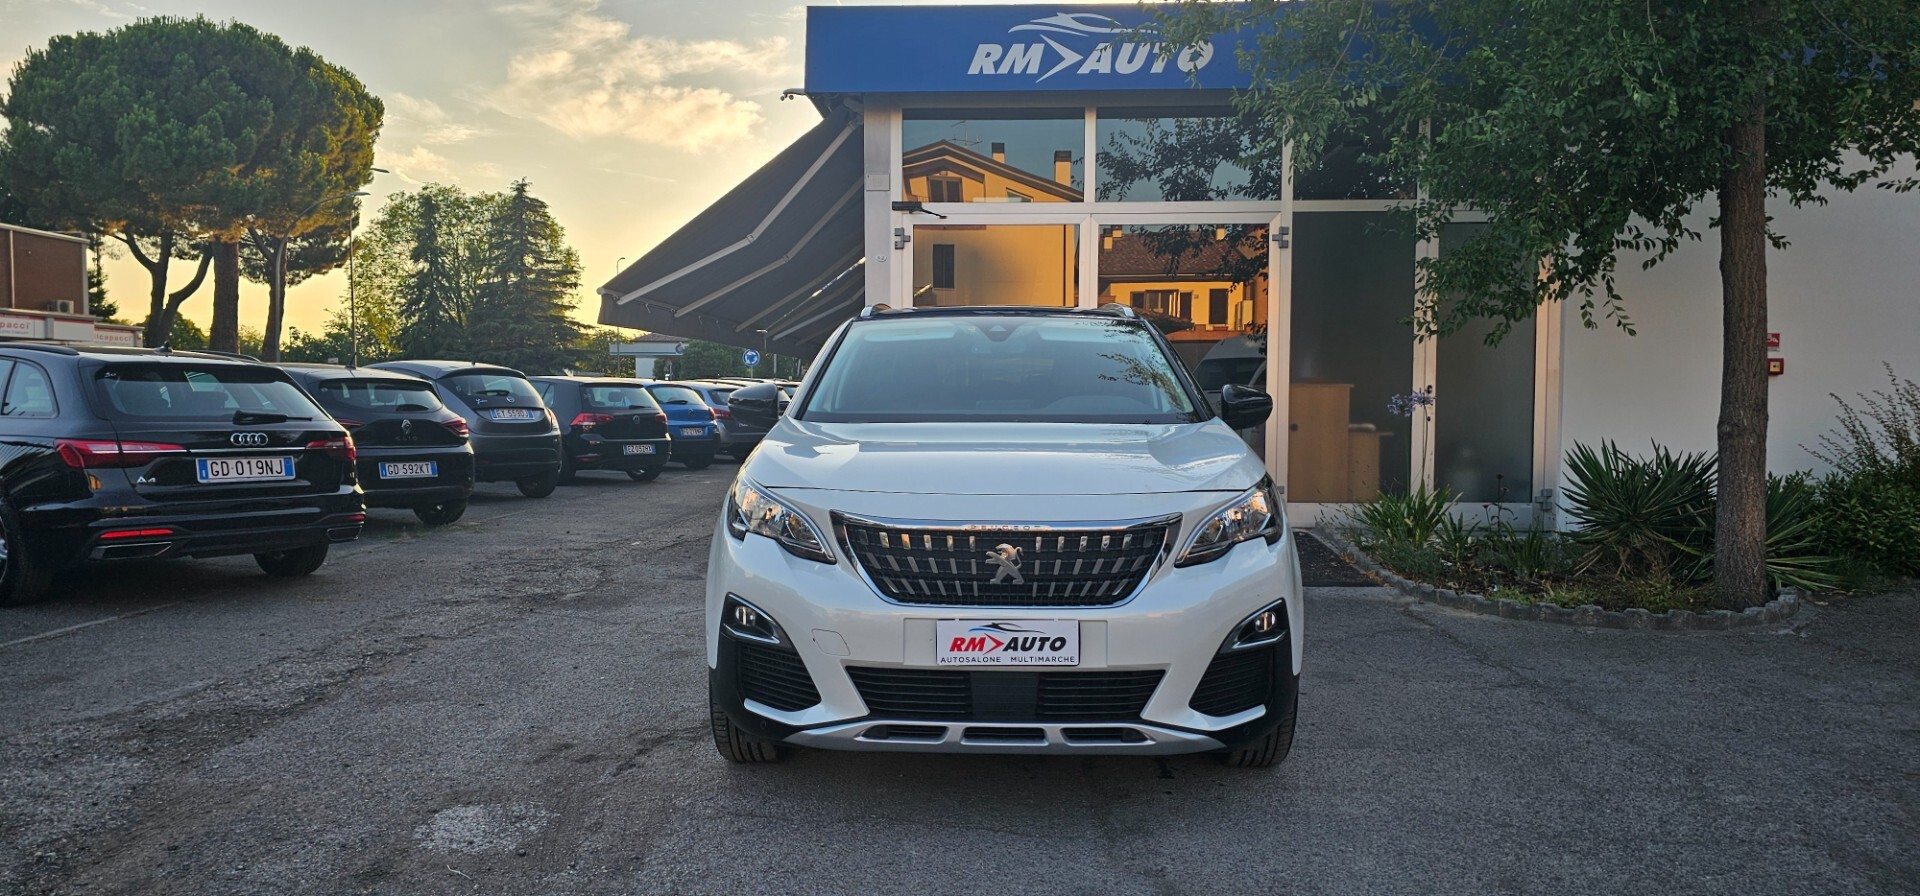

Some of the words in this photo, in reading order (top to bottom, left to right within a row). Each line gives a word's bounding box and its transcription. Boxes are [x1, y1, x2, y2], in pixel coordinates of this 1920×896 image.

[967, 43, 1045, 75] RM
[1076, 40, 1214, 75] AUTO
[235, 459, 283, 476] 019NJ
[949, 637, 987, 652] RM
[1002, 636, 1067, 652] AUTO
